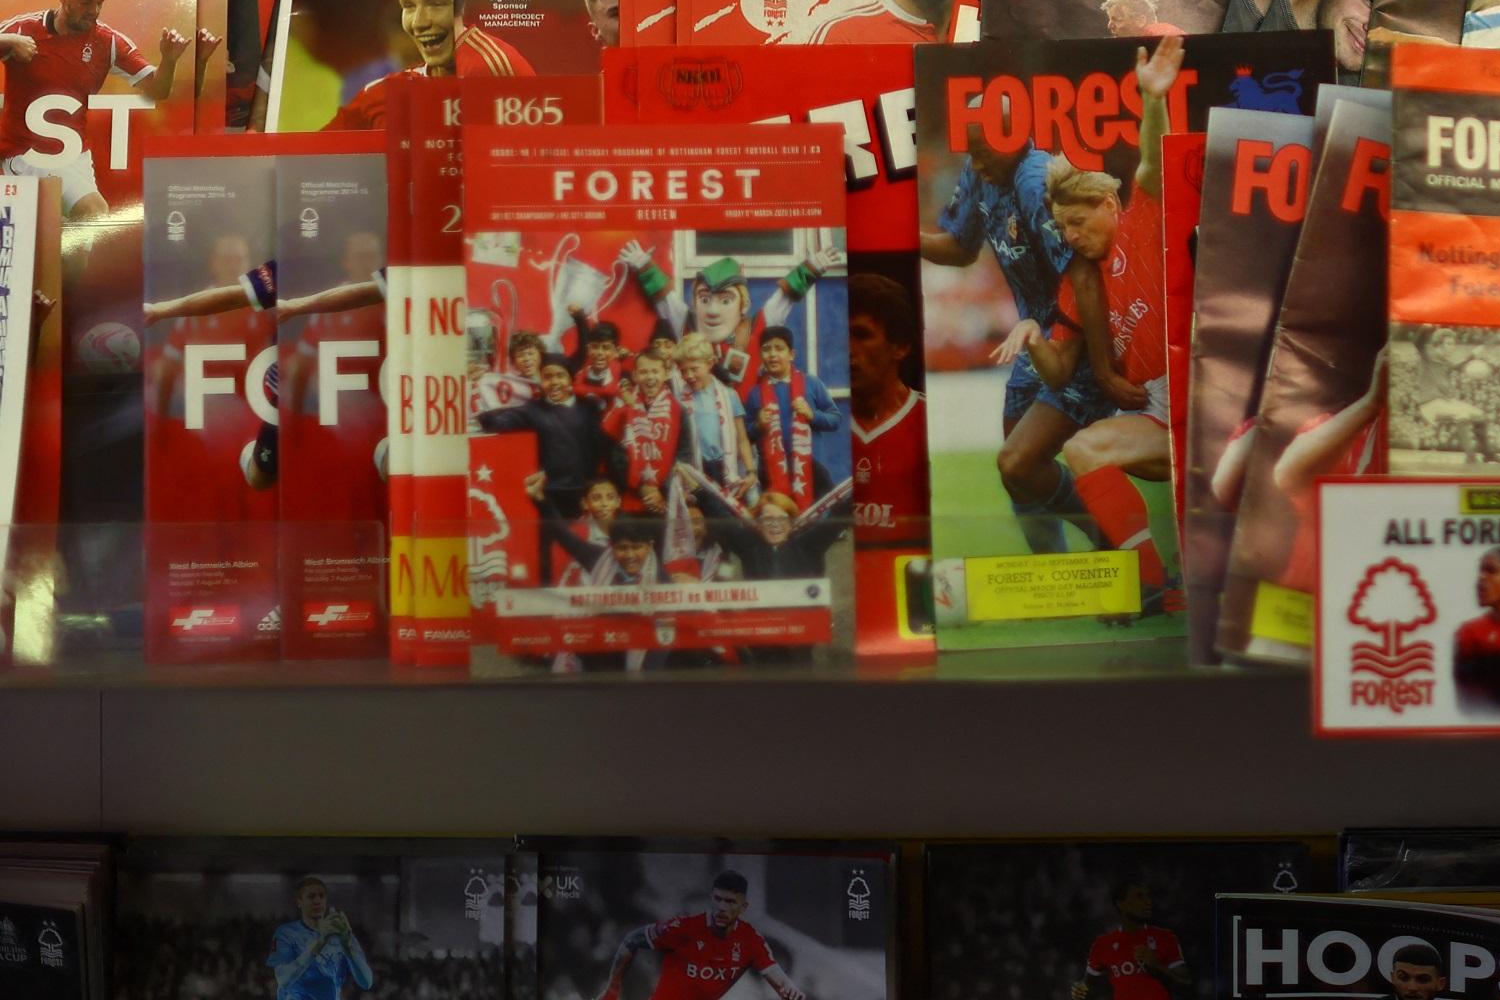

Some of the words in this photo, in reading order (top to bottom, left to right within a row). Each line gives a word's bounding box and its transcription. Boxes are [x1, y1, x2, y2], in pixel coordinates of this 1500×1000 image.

[492, 2, 528, 11] Sponsor
[494, 98, 564, 125] 1865
[553, 170, 760, 201] FOREST
[1427, 174, 1485, 190] OFFICIAL
[636, 209, 678, 221] REVIEW
[1384, 518, 1433, 545] ALL
[988, 573, 1034, 584] FOREST
[1052, 567, 1119, 581] COVENTRY
[704, 588, 759, 603] MILLWALL
[556, 876, 579, 890] UK
[687, 963, 740, 981] BOXT
